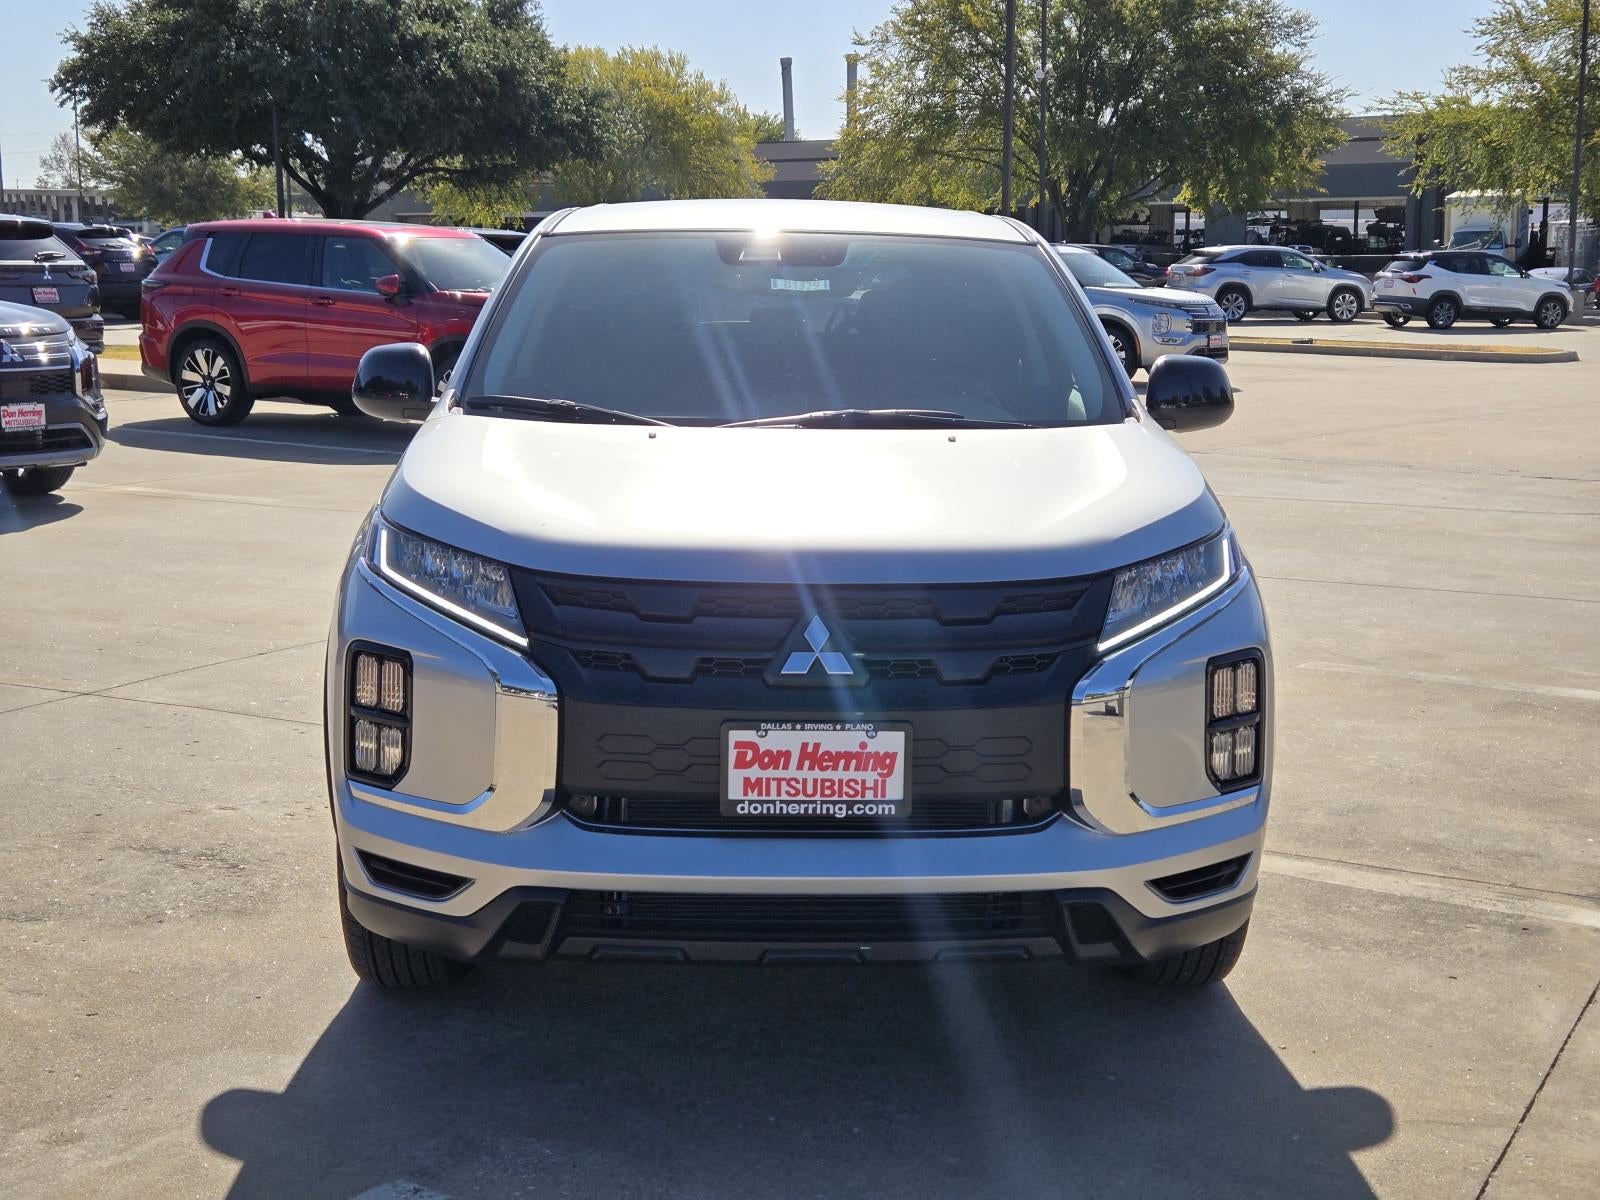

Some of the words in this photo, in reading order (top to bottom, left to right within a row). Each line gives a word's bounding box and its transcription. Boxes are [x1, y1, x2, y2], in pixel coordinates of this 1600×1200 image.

[2, 409, 17, 419] Don
[18, 407, 43, 419] Herring
[5, 418, 42, 427] MITSUBISHI
[845, 723, 874, 731] PLANO
[733, 740, 792, 770] Don
[796, 741, 898, 779] Herring
[742, 776, 887, 799] MITSUBISHI
[736, 800, 896, 818] donherring.com
